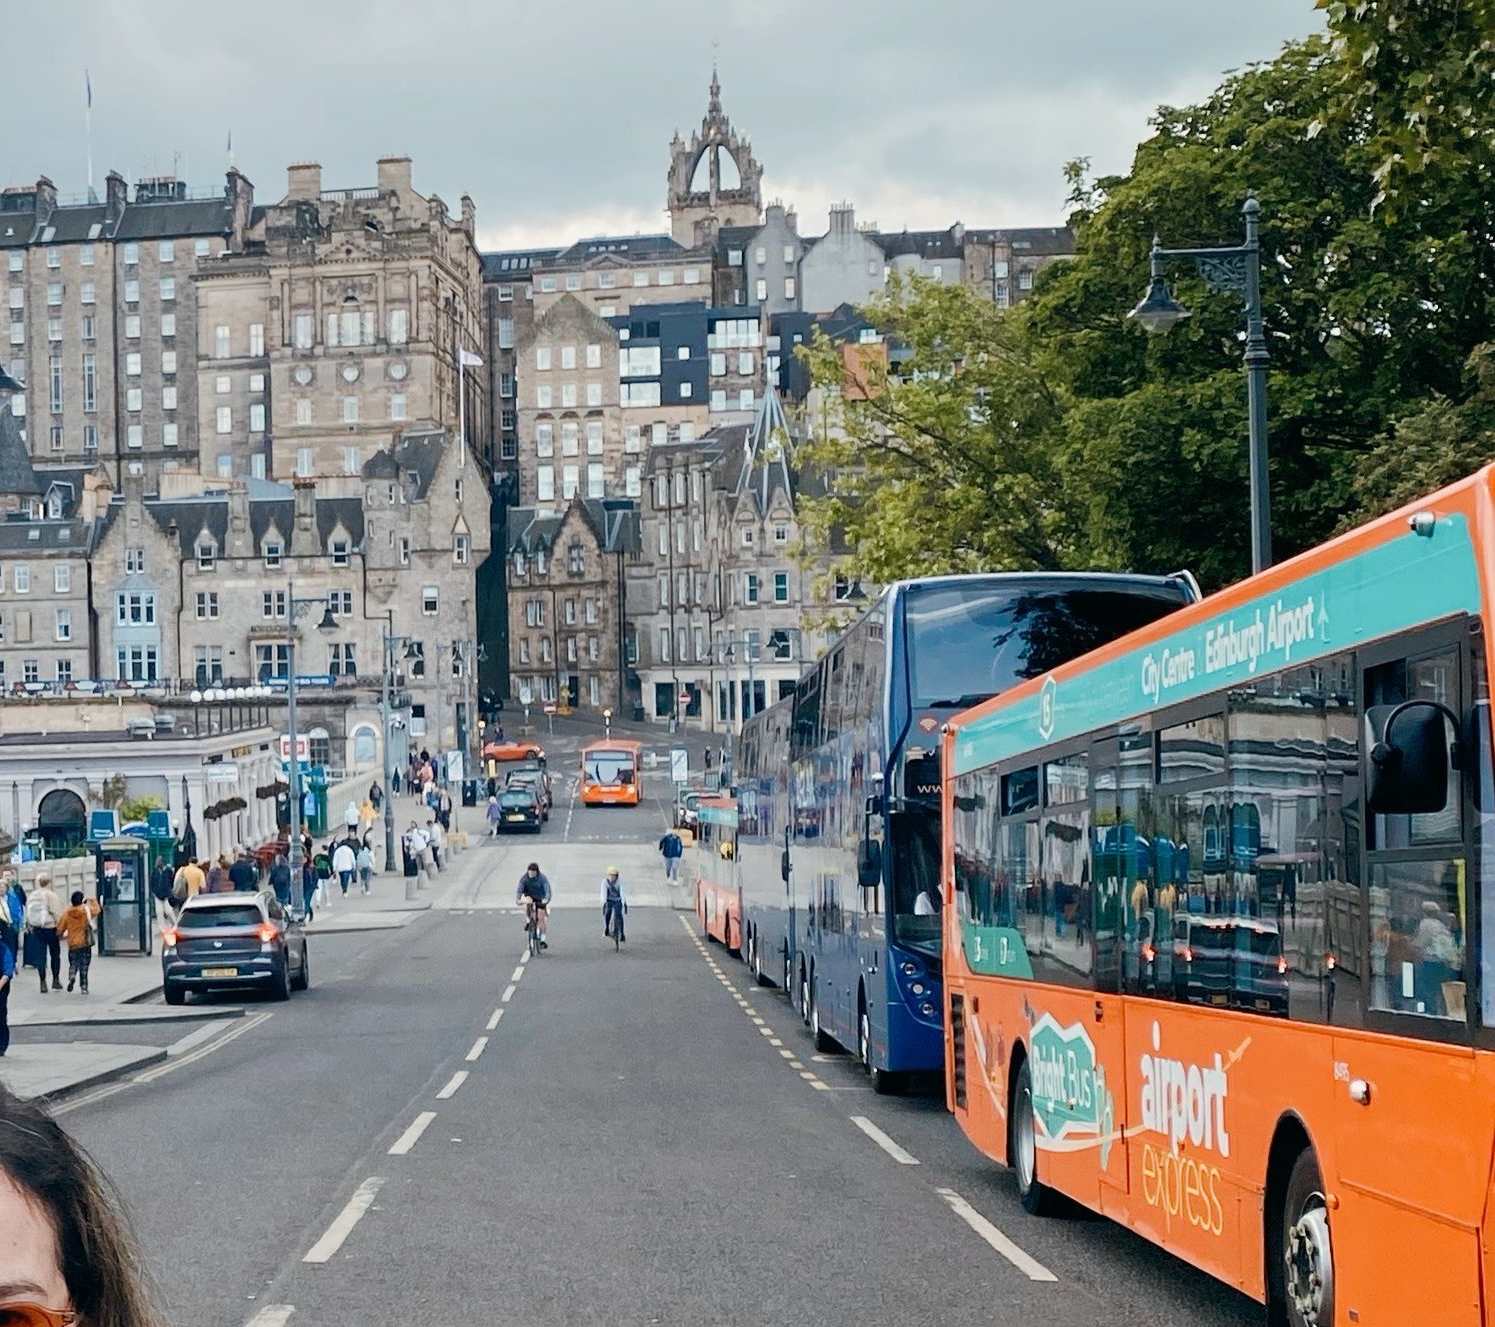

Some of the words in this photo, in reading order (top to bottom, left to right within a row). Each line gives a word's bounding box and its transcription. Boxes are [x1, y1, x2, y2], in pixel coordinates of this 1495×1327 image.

[1141, 651, 1161, 704] City
[1161, 647, 1196, 689] Centre
[1206, 607, 1266, 673] Edinburgh
[1266, 595, 1315, 662] Airport
[1032, 1044, 1067, 1113] Bright
[1066, 1049, 1092, 1109] Bus
[1141, 1020, 1230, 1159] airport
[1141, 1143, 1223, 1237] express
